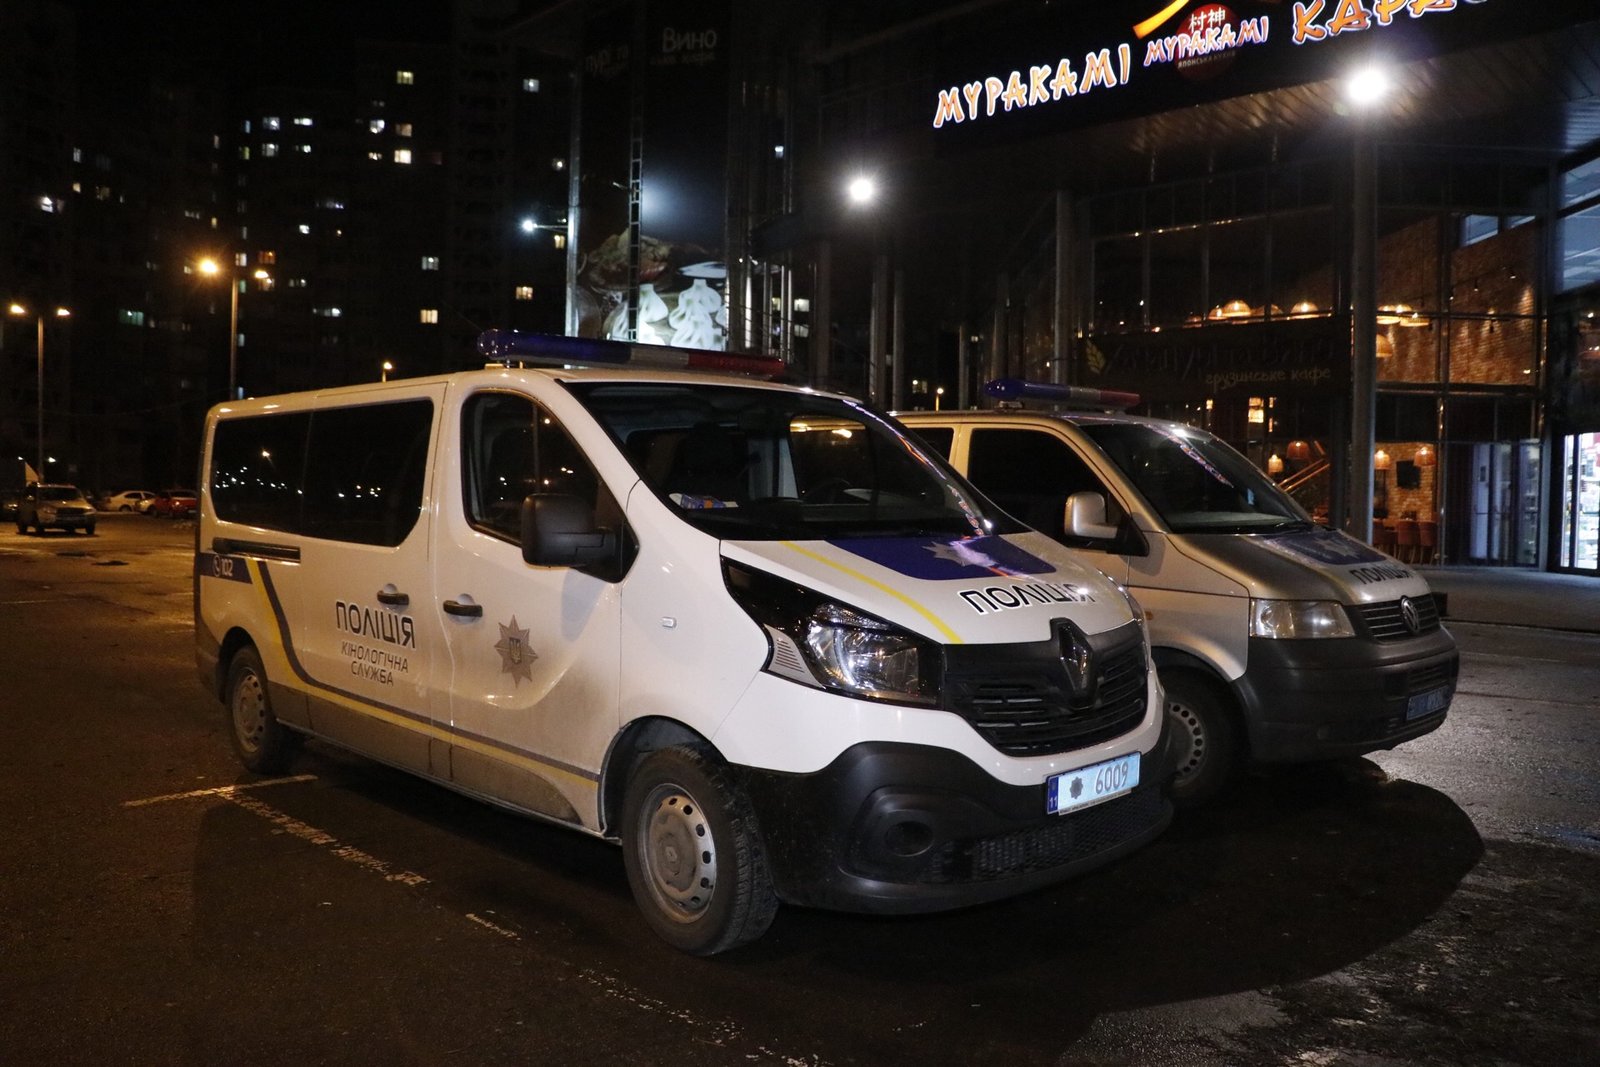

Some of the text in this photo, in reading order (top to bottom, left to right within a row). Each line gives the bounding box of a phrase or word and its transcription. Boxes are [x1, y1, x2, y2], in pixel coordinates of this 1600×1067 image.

[1188, 6, 1226, 33] 村神
[1291, 0, 1487, 45] КАР
[661, 27, 718, 53] Вино
[1143, 16, 1269, 67] МУРАКАМІ
[933, 43, 1131, 128] МУРАКАМІ
[1205, 365, 1332, 394] грузинське кафе
[958, 583, 1097, 614] ПОЛІЦІЯ
[335, 600, 416, 649] ПОЛІЦІЯ
[341, 641, 409, 673] КІНОЛОГІЧНА
[350, 660, 394, 686] СЛУЖБА
[1095, 761, 1129, 794] 6009
[1049, 795, 1058, 809] 11
